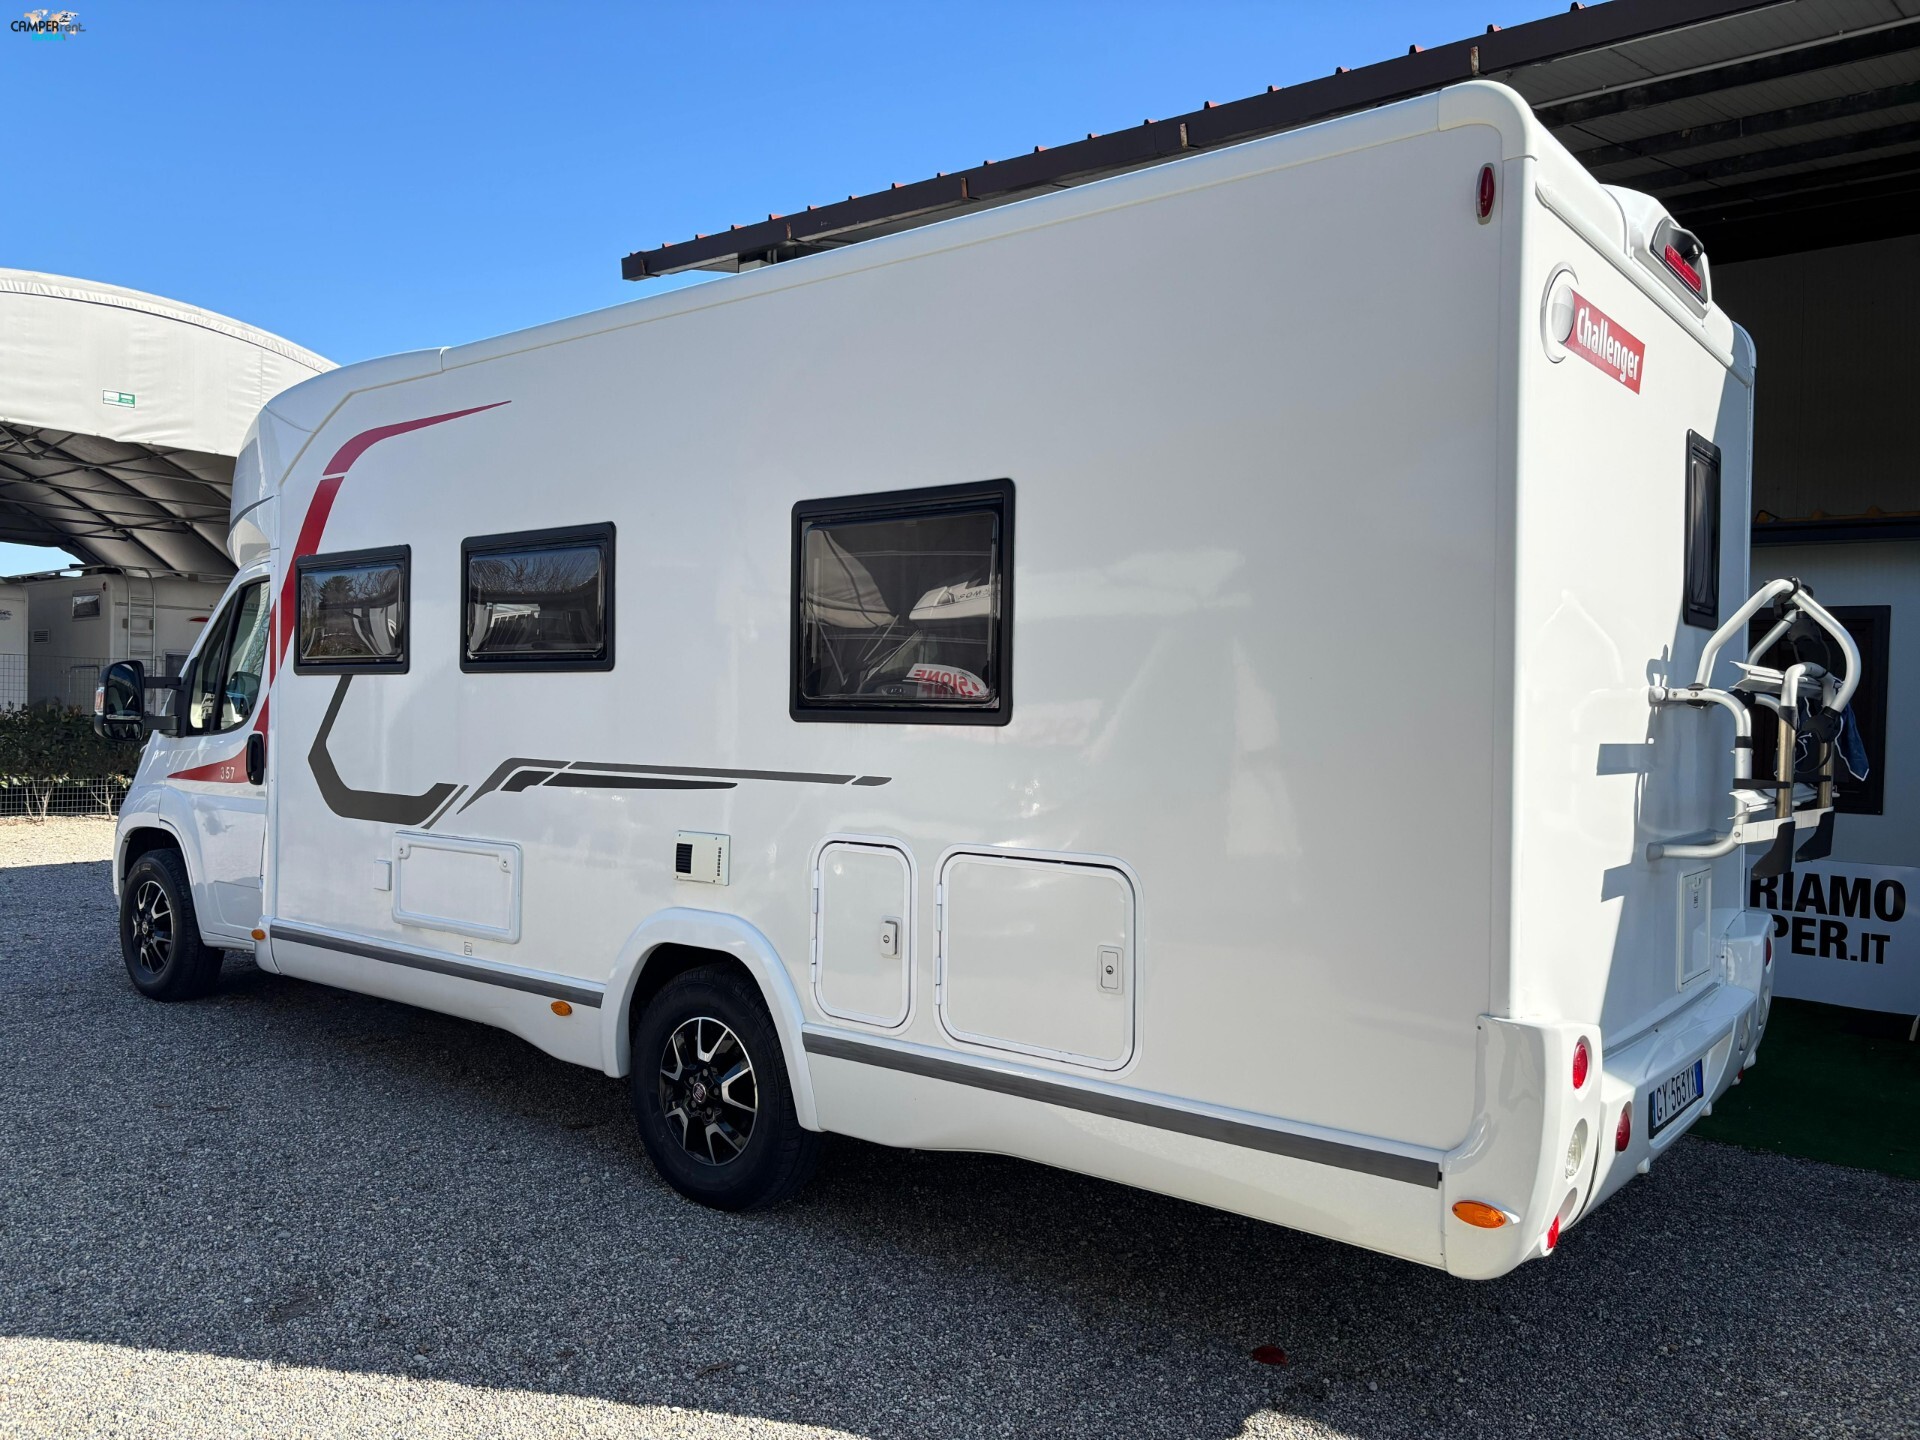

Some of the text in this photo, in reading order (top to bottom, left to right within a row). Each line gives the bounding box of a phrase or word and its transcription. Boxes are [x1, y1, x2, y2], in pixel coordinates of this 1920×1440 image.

[1577, 307, 1639, 382] Challenger
[220, 766, 235, 780] 357
[1745, 869, 1906, 922] RIAMO
